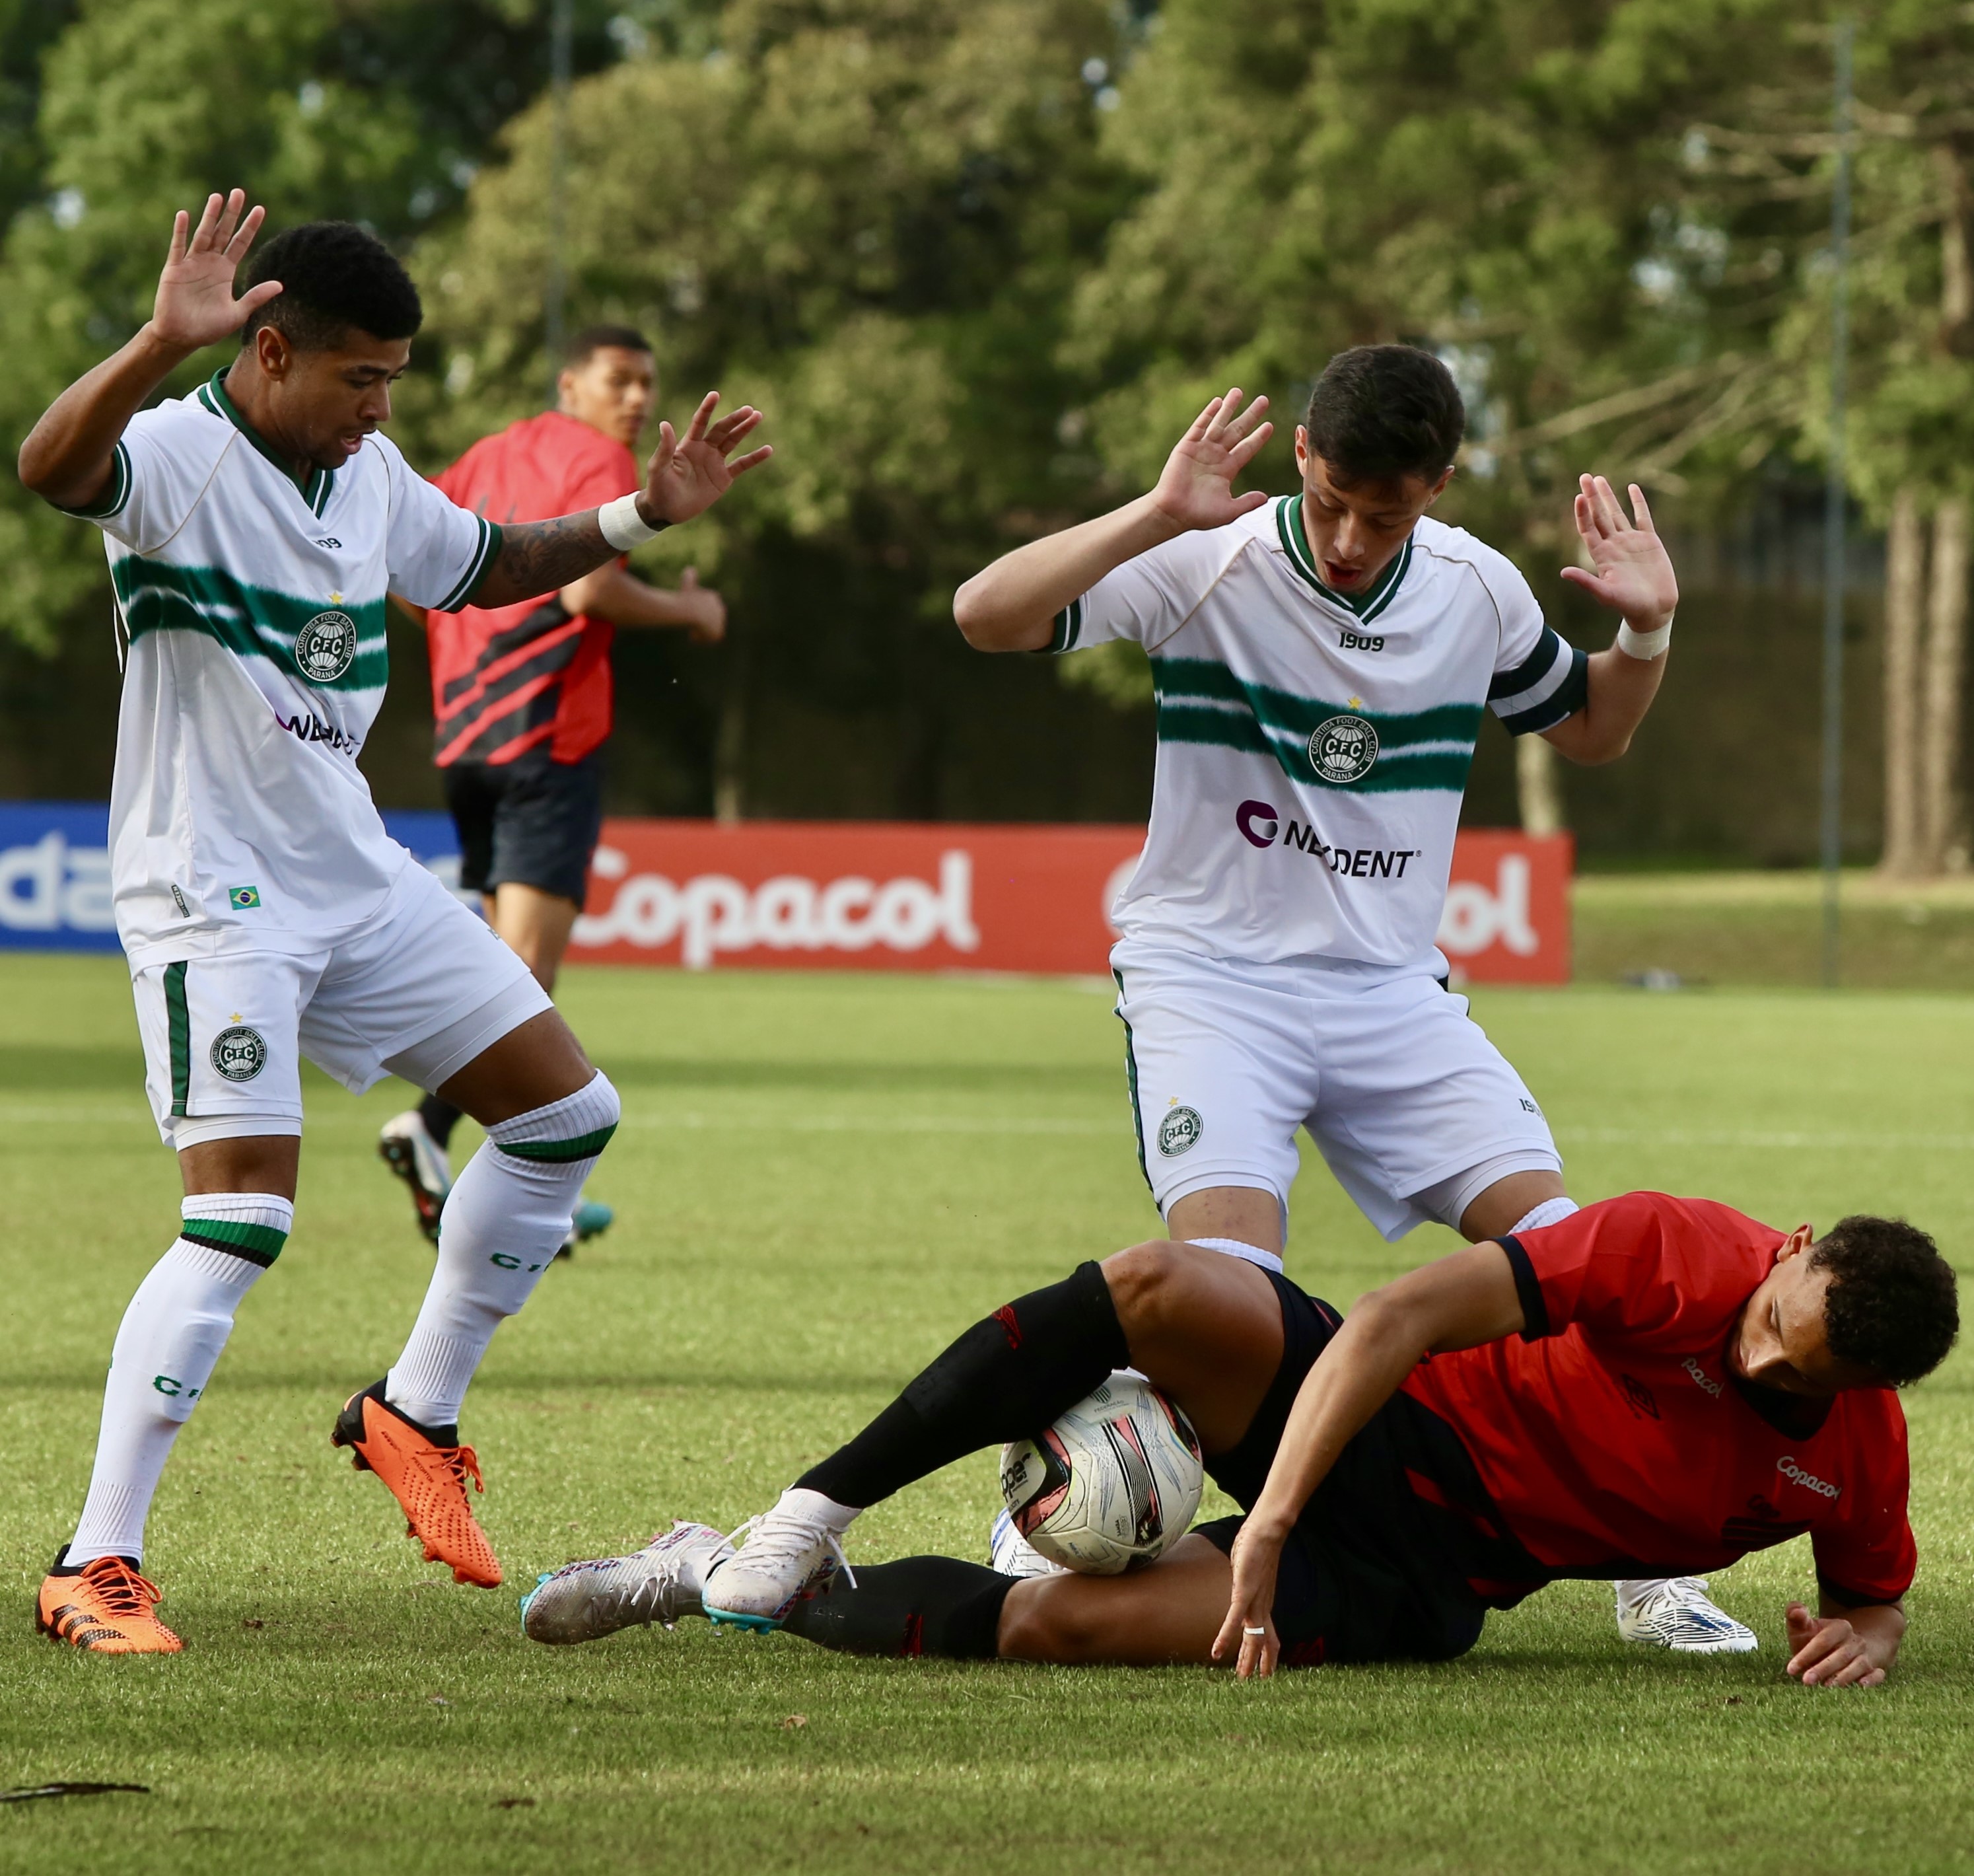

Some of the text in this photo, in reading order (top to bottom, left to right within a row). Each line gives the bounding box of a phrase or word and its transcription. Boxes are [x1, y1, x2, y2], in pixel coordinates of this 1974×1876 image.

[339, 617, 353, 634] BALL
[310, 636, 342, 655] CFC
[345, 635, 354, 659] CLUB
[1339, 632, 1384, 652] 1909
[1312, 721, 1334, 754] CORITIBA
[1358, 723, 1374, 739] BALL
[1325, 739, 1362, 757] CFC
[1364, 740, 1376, 762] CLUB
[224, 1046, 254, 1061] CFC
[1166, 1122, 1190, 1141] CFC
